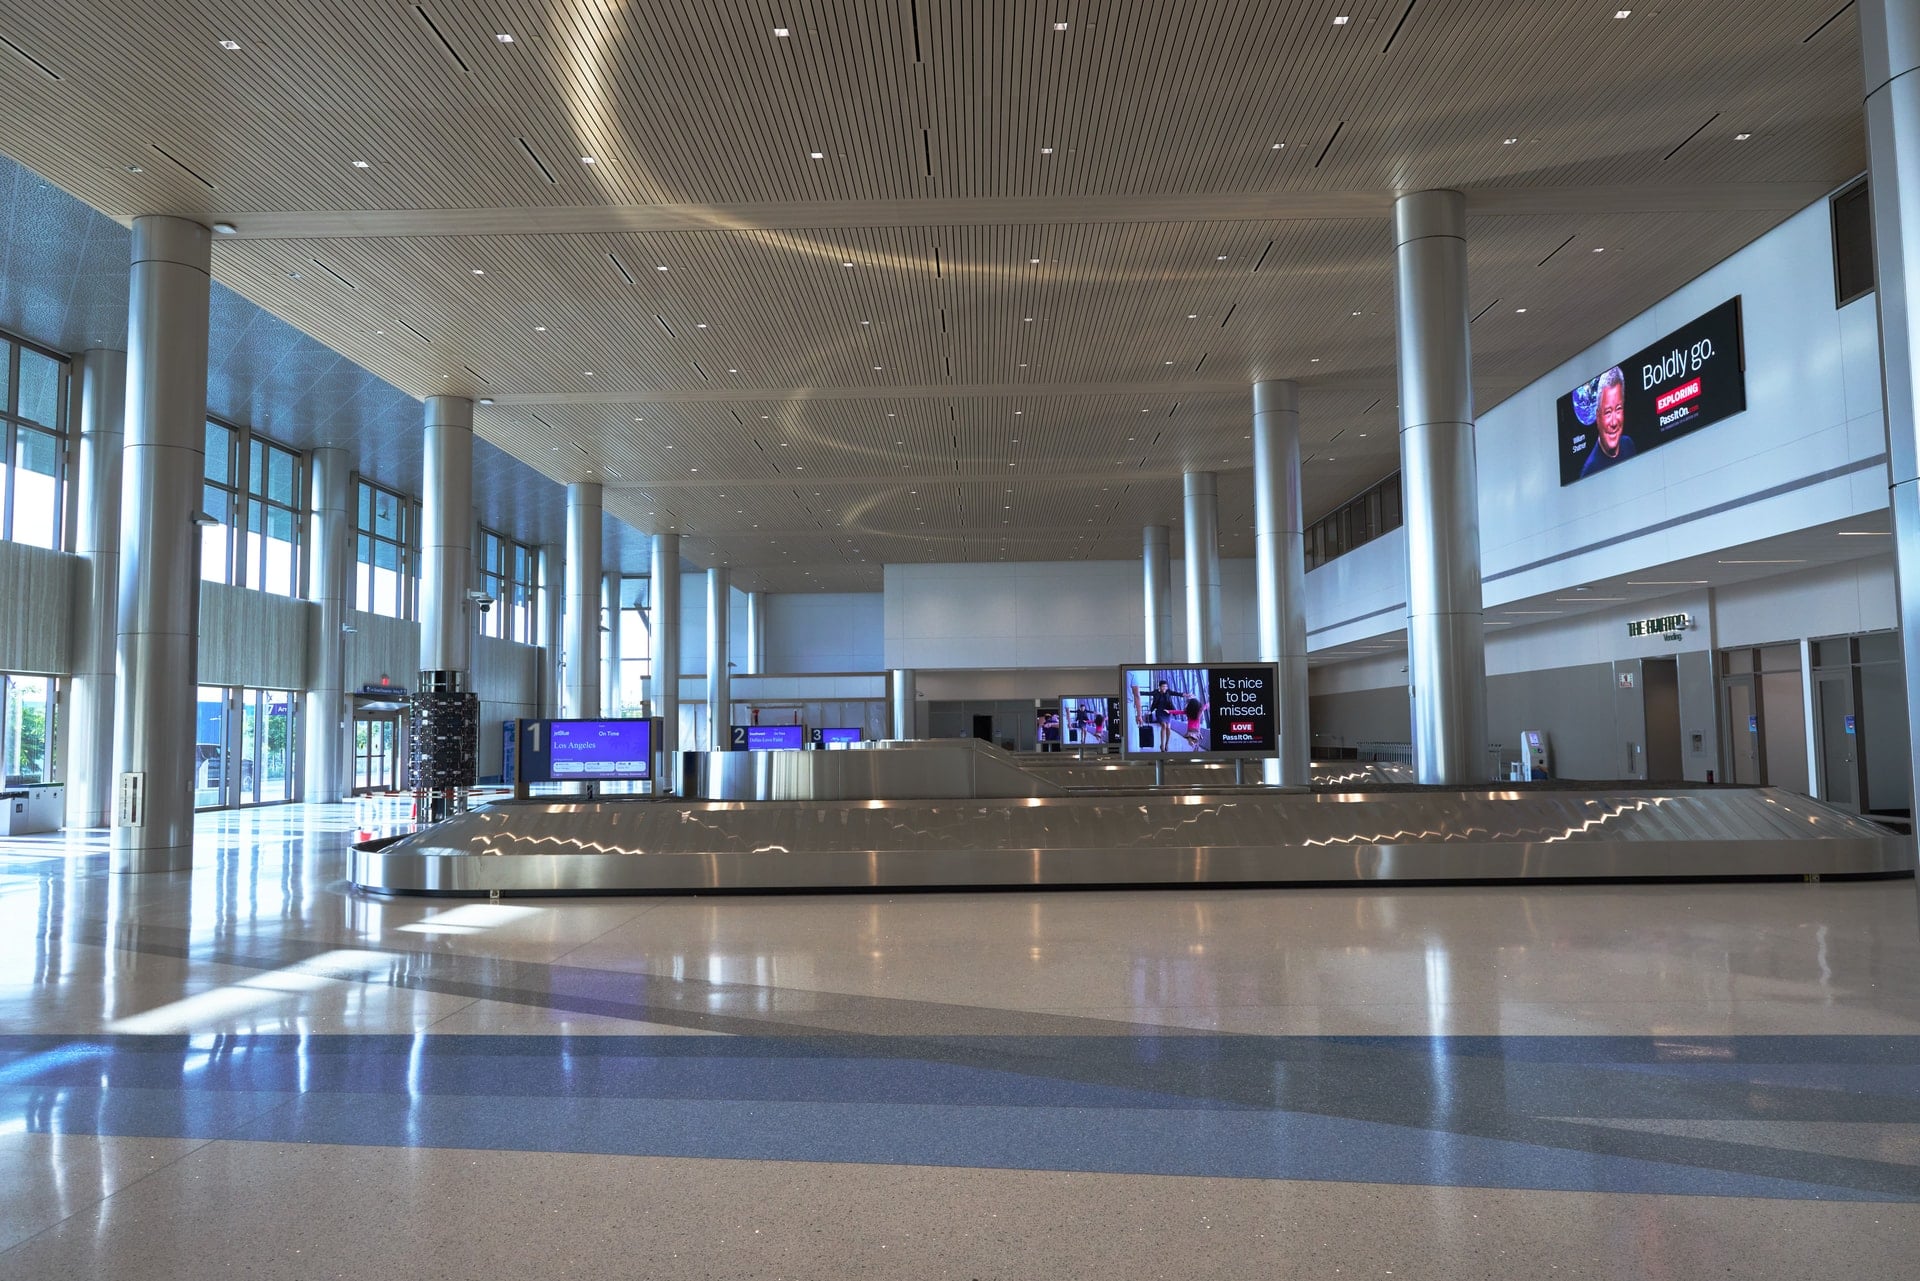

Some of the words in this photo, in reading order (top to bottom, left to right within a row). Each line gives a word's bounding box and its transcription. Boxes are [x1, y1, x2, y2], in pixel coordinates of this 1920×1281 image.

[1643, 349, 1687, 390] Boldly
[1691, 338, 1715, 371] go.
[1657, 382, 1699, 410] EXPLORING
[1627, 620, 1646, 637] THE
[1220, 676, 1236, 689] It's
[1238, 677, 1263, 689] nice
[1226, 691, 1239, 702] to
[1241, 691, 1257, 702] be
[1220, 704, 1266, 716] missed.
[527, 722, 540, 752] 1
[734, 727, 745, 744] 2
[813, 729, 821, 740] 3
[553, 741, 566, 749] Los
[567, 741, 596, 751] Angeles
